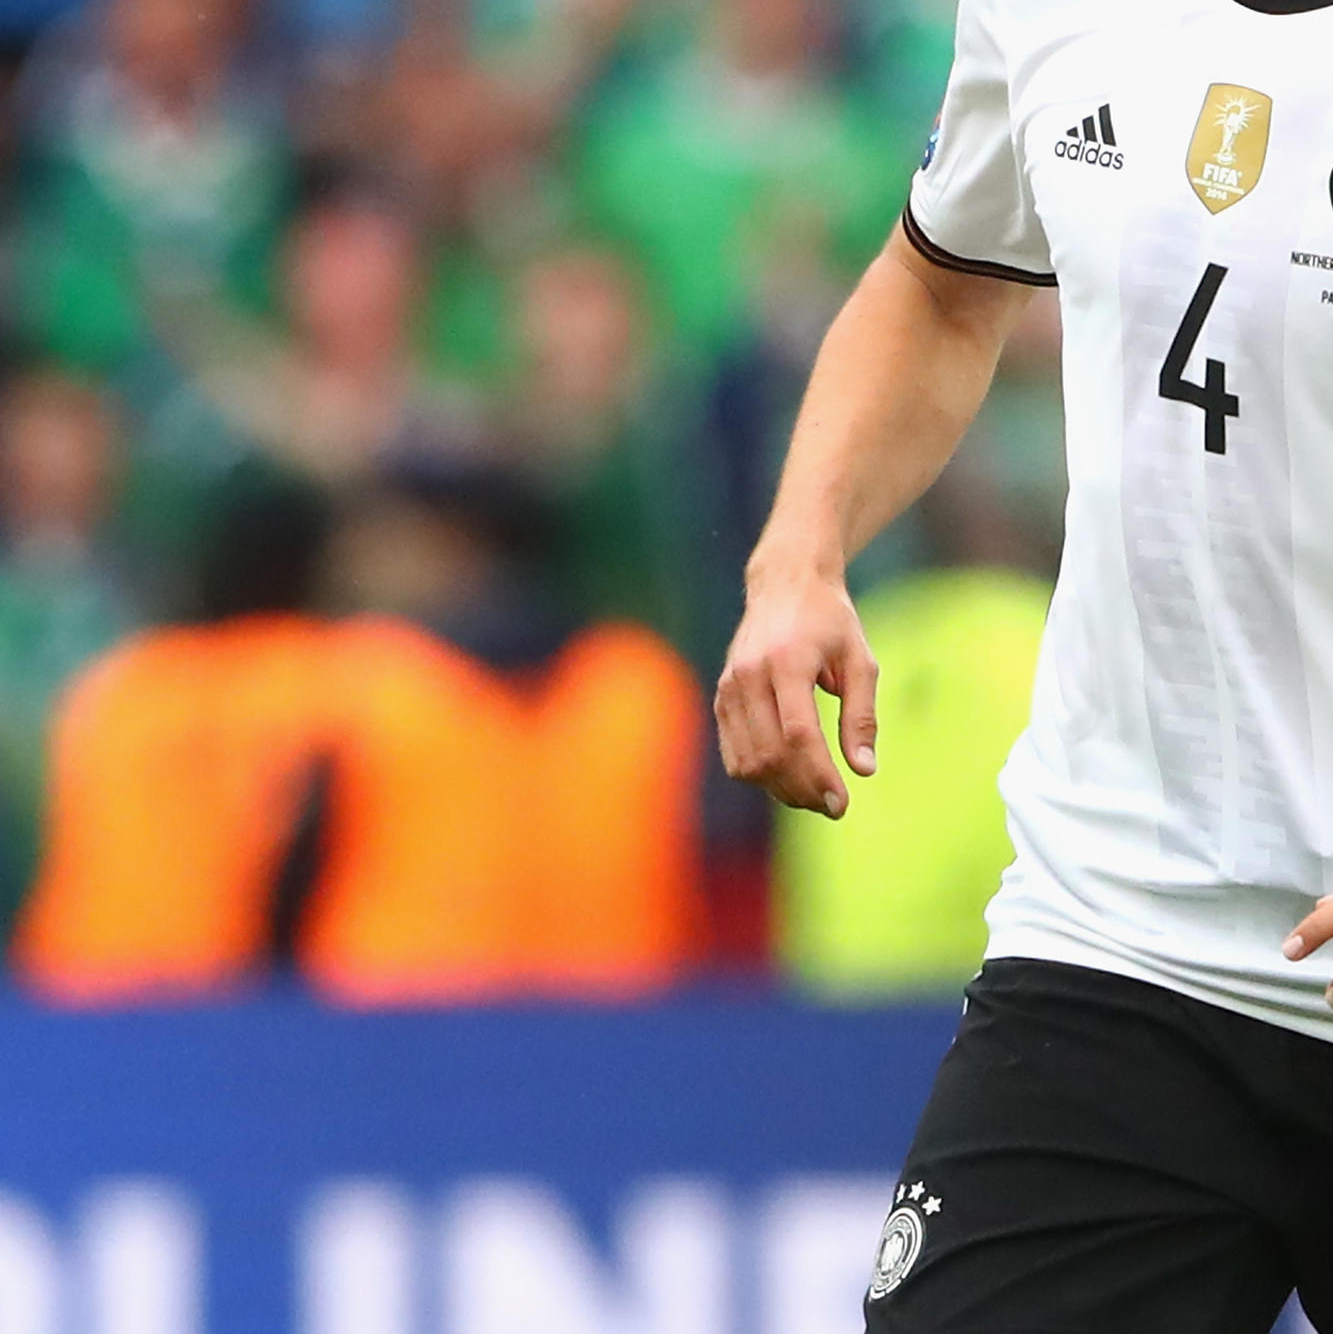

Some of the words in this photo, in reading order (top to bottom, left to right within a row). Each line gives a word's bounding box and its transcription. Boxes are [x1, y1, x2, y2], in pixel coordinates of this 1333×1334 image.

[1055, 139, 1124, 170] adidas
[1203, 163, 1238, 186] FIFA
[1158, 262, 1240, 456] 4
